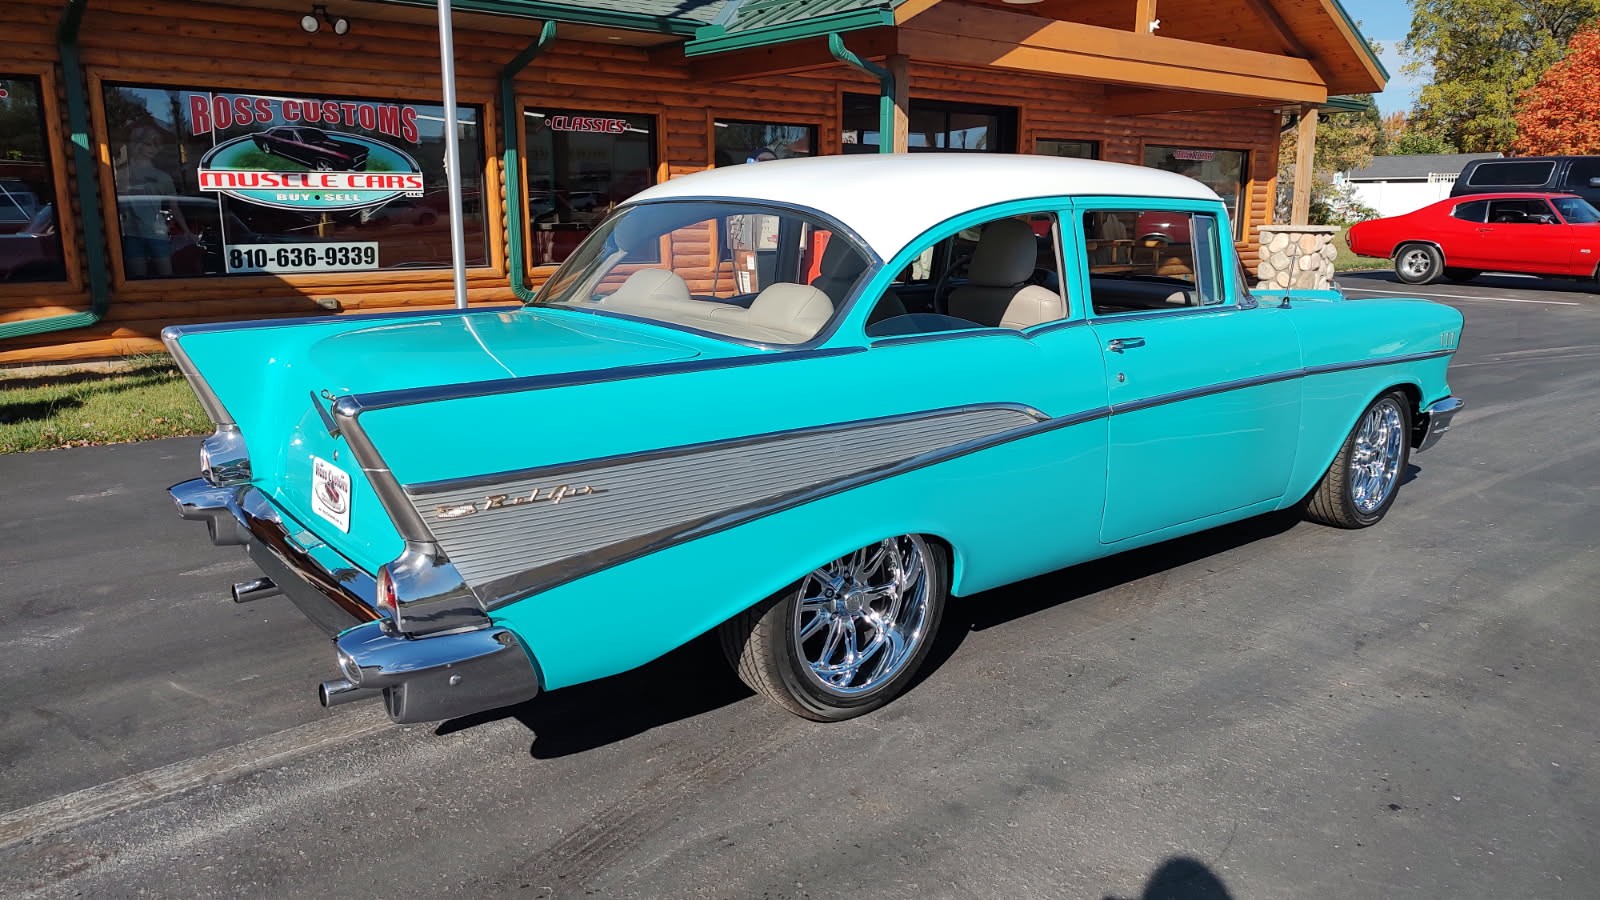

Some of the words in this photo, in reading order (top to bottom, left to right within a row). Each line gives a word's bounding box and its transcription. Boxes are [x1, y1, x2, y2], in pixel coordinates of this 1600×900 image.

[189, 95, 274, 136] ROSS
[282, 101, 419, 143] CUSTOMS
[552, 116, 626, 133] CLASSICS
[200, 172, 337, 188] MUSCLE
[347, 174, 423, 189] CARS
[276, 193, 310, 201] BUY
[324, 193, 361, 201] SELL
[229, 246, 376, 269] 810-636-9339
